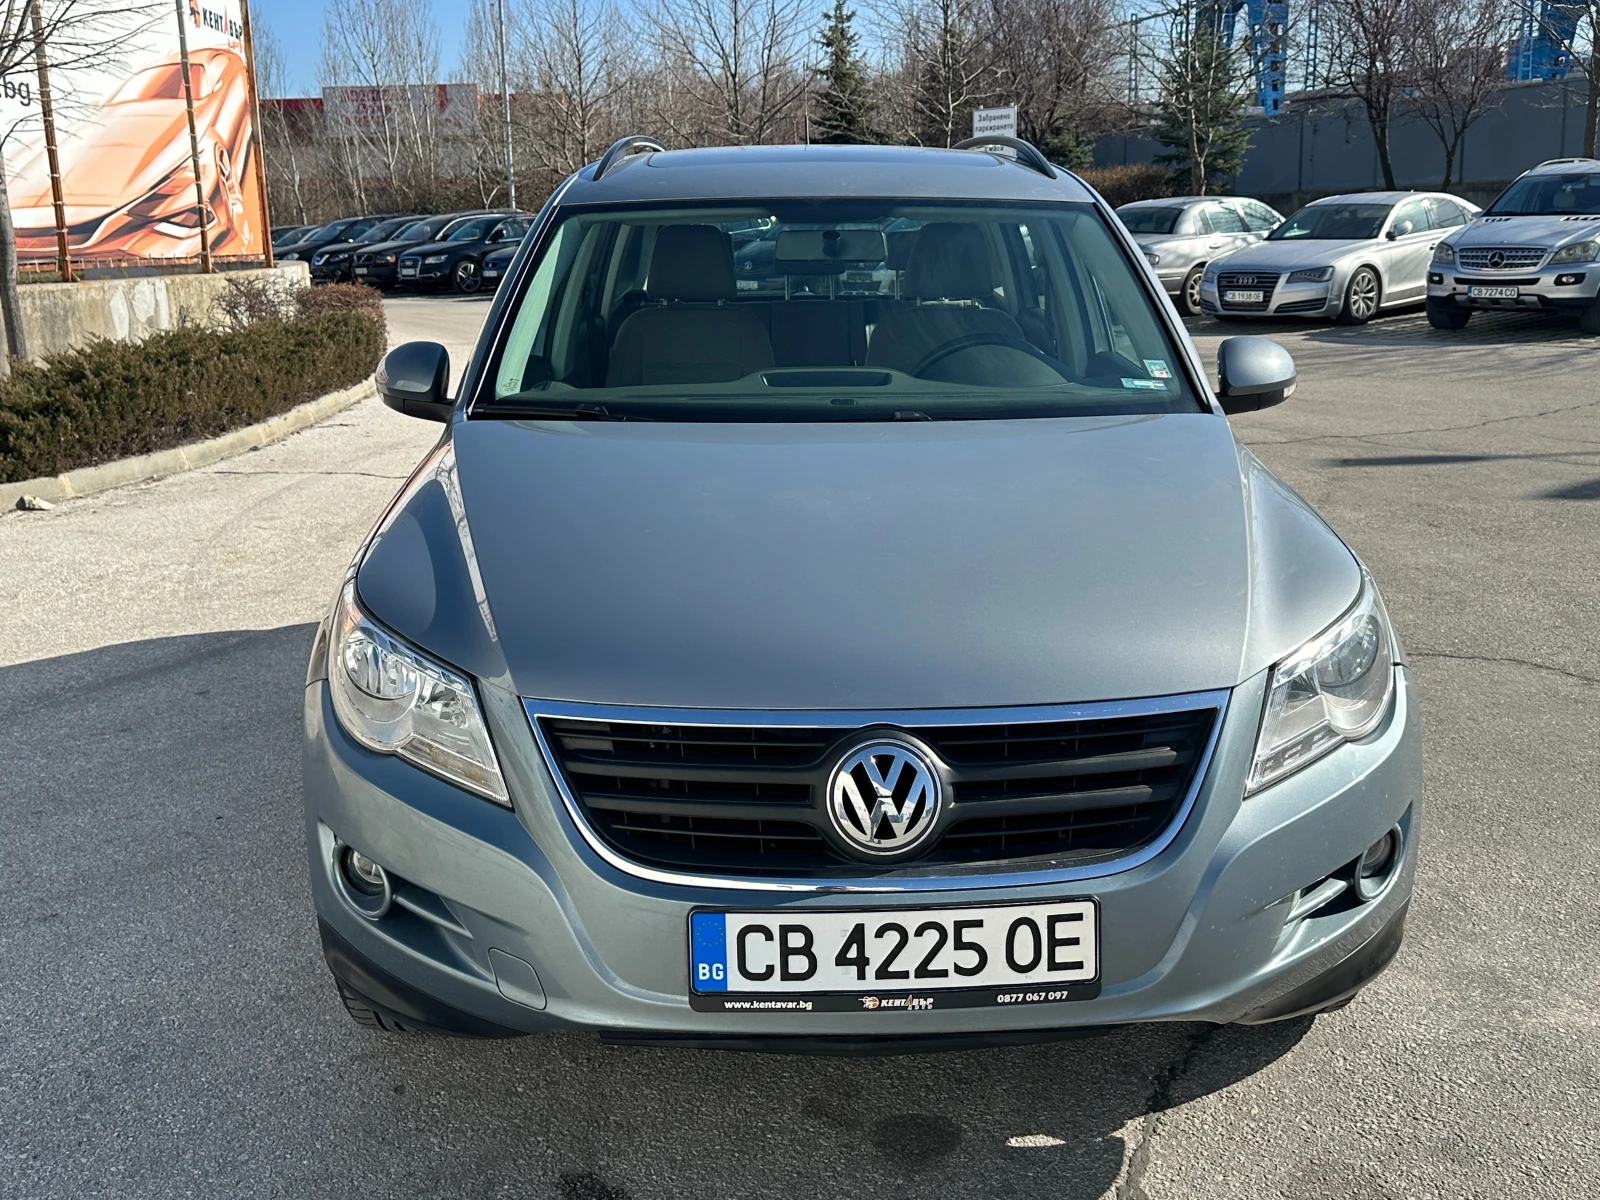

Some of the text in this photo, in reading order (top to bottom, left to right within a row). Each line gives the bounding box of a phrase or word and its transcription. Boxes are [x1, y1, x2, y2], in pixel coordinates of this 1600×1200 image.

[202, 5, 242, 41] КЕНТАВЪР
[978, 114, 1011, 122] Забранено
[975, 123, 1014, 133] паркирането
[1238, 292, 1252, 300] 1938
[1473, 288, 1515, 296] CB 7274 CO
[736, 912, 1084, 982] CB 4225 OE
[698, 963, 724, 981] BG
[881, 994, 934, 1007] КЕНТАВЪР
[997, 991, 1068, 1004] 0877 067 097
[724, 999, 813, 1011] www.kentavar.bg
